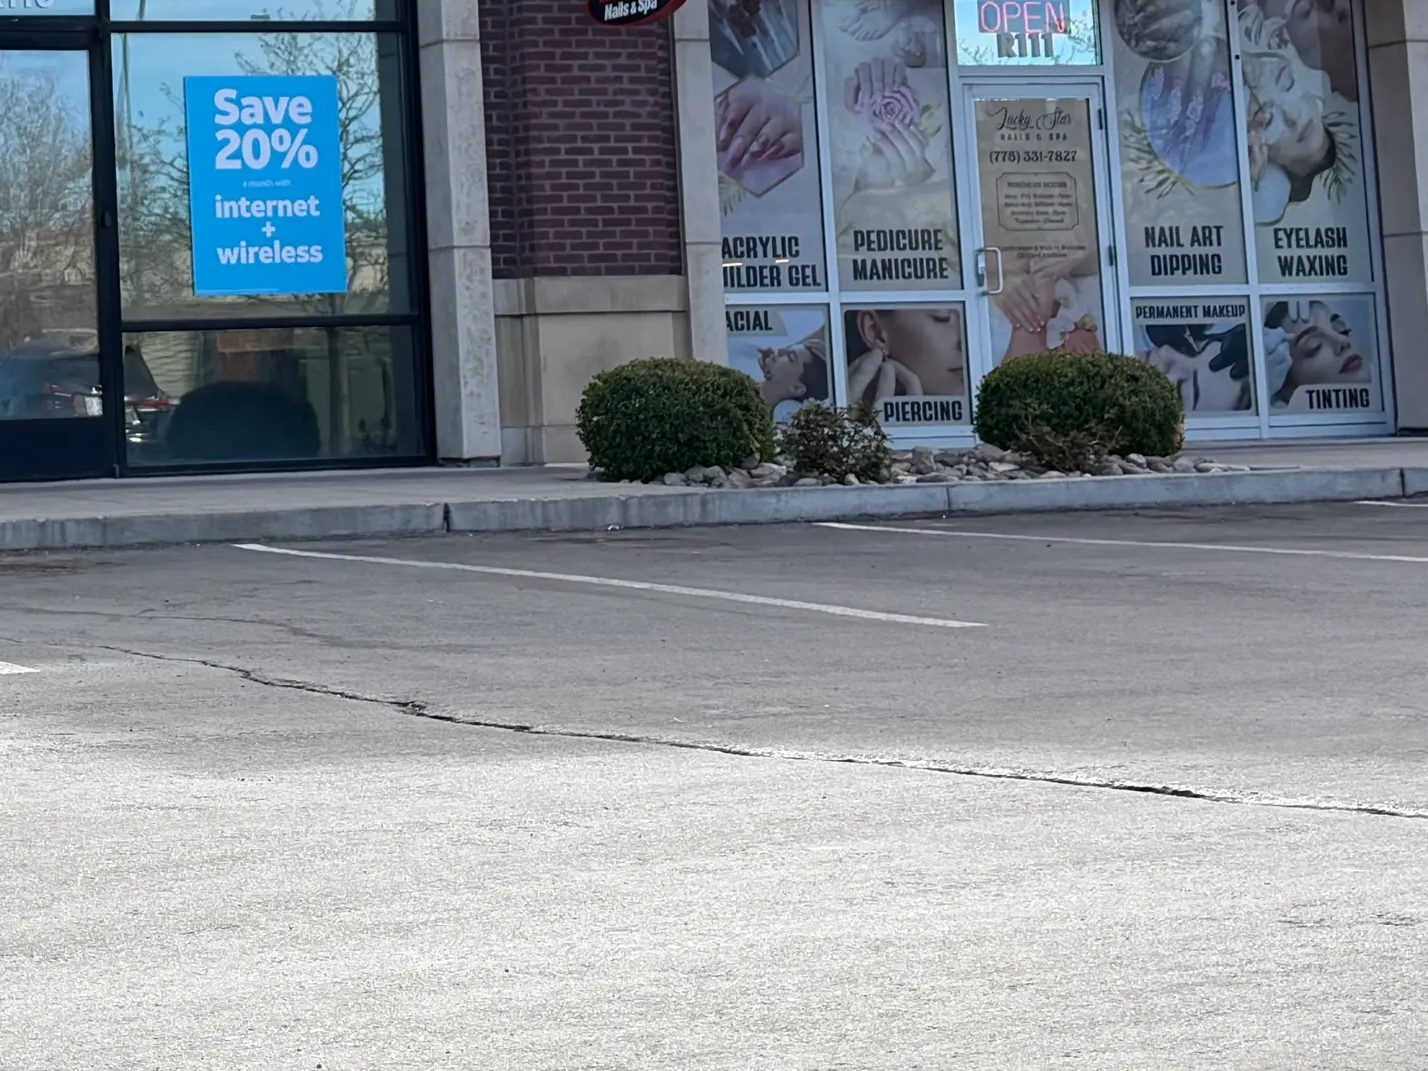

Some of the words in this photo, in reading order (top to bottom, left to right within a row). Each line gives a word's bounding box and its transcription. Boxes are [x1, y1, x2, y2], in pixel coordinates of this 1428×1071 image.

[604, 0, 630, 21] Nails
[630, 1, 637, 14] &
[980, 1, 1066, 33] OPEN
[997, 33, 1054, 58] R111
[213, 88, 313, 125] Save
[986, 106, 1034, 131] Lucky
[1036, 107, 1072, 131] Star
[215, 128, 319, 170] 20%
[215, 194, 320, 218] internet
[722, 236, 800, 259] ACRYLIC
[854, 229, 943, 252] PEDICURE
[1144, 226, 1185, 248] NAIL
[1190, 225, 1224, 248] ART
[1274, 227, 1348, 249] EYELASH
[216, 240, 323, 264] wireless
[788, 264, 822, 287] GEL
[853, 257, 949, 281] MANICURE
[1150, 253, 1222, 276] DIPPING
[1277, 255, 1348, 277] WAXING
[726, 310, 773, 332] ACIAL
[1135, 305, 1198, 319] PERMANENT
[1203, 304, 1246, 318] MAKEUP
[1306, 388, 1370, 410] TINTING
[883, 400, 963, 422] PIERCING
